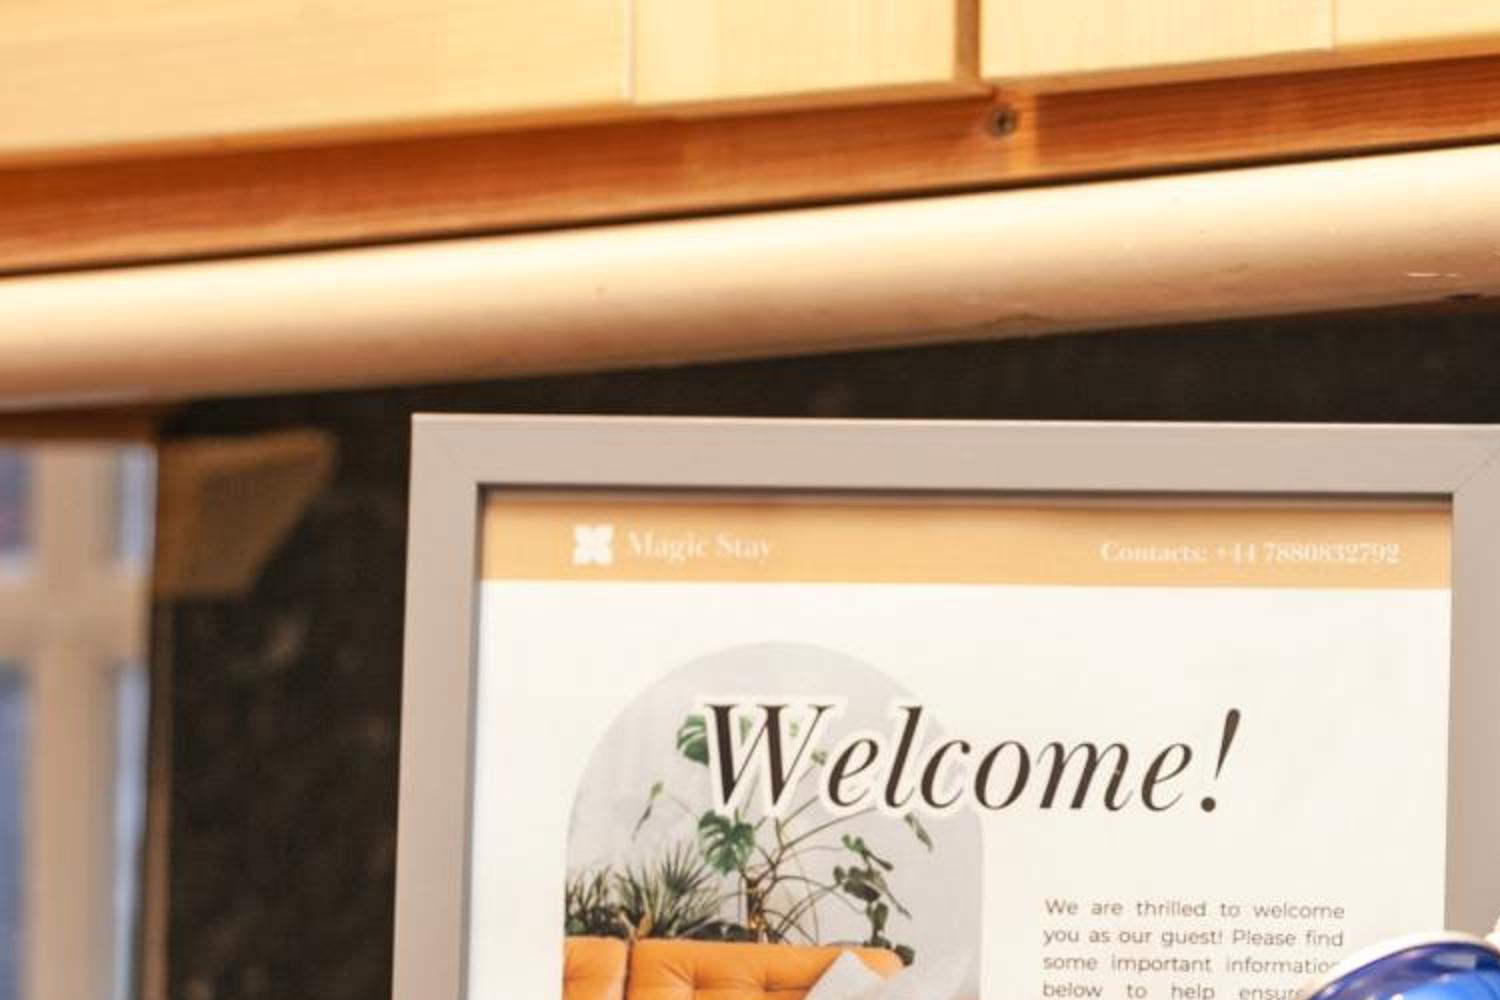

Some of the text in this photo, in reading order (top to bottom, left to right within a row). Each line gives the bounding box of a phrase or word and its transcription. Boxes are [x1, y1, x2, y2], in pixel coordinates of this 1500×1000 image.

[627, 530, 771, 565] Magic Stay
[1100, 542, 1206, 564] Contacts:
[703, 703, 1241, 813] Welcome!
[1045, 900, 1345, 920] We are thrilled to welcome
[1042, 928, 1344, 948] you as our guest! Please find
[1043, 956, 1098, 970] some
[1111, 953, 1212, 976] important
[1043, 981, 1103, 999] below
[1127, 984, 1148, 1000] to
